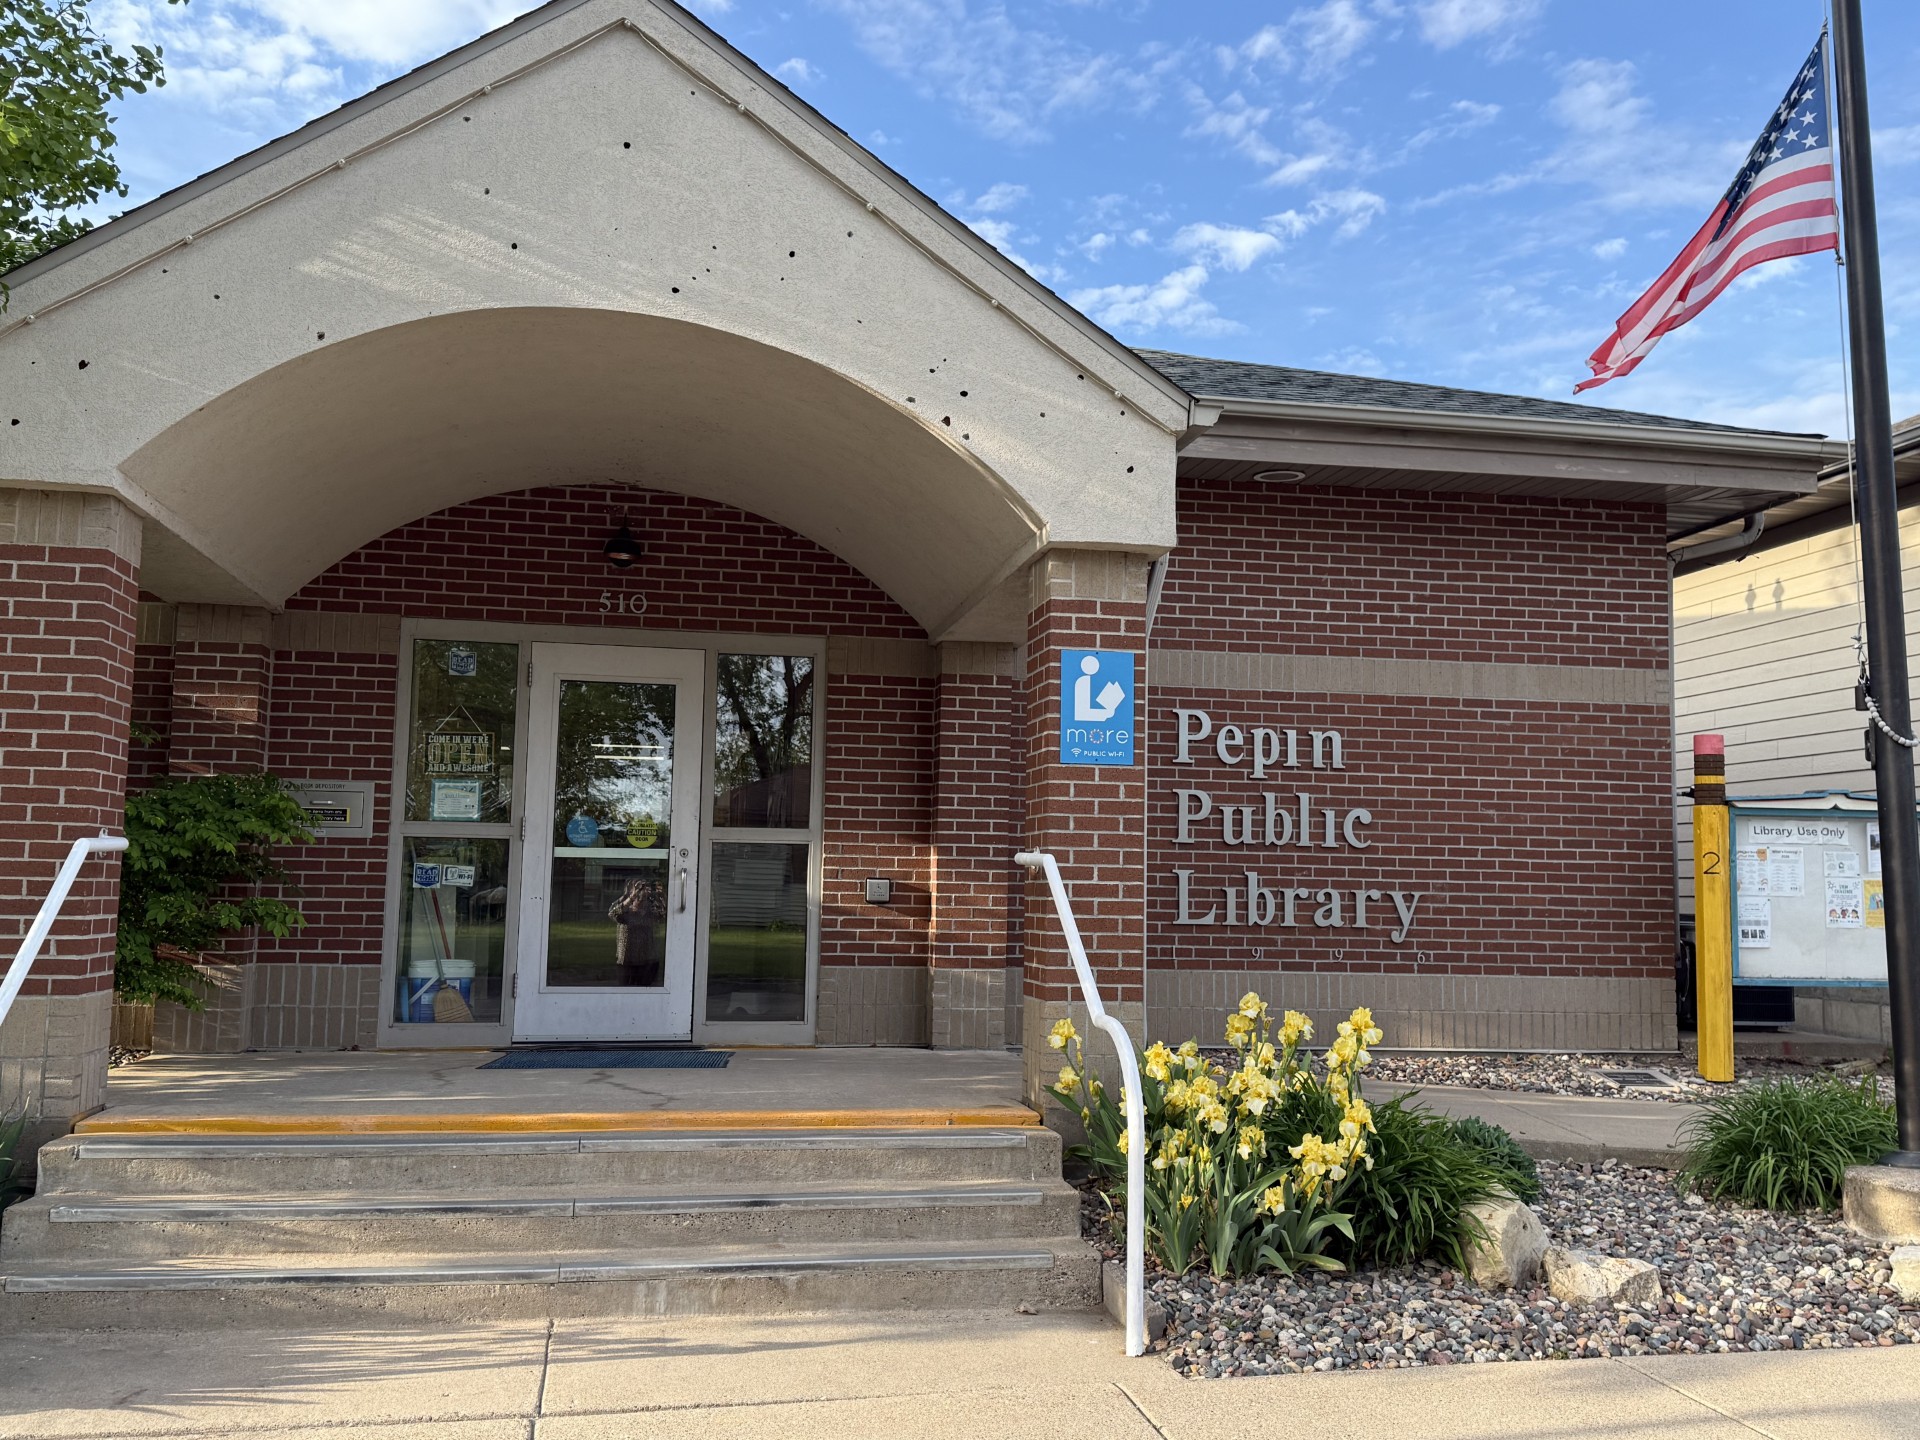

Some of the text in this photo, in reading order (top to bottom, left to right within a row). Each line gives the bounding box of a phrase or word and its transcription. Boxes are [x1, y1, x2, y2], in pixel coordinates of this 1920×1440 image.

[599, 592, 647, 614] 510
[428, 735, 451, 743] COME
[452, 735, 461, 743] IN
[1067, 728, 1129, 744] more
[1172, 708, 1346, 779] Pepin
[427, 743, 489, 765] OPEN
[427, 763, 489, 772] AND AWESOME
[1172, 788, 1373, 849] Public
[1753, 825, 1845, 839] Library Use Only
[1702, 851, 1721, 875] 2
[1172, 869, 1426, 944] Library
